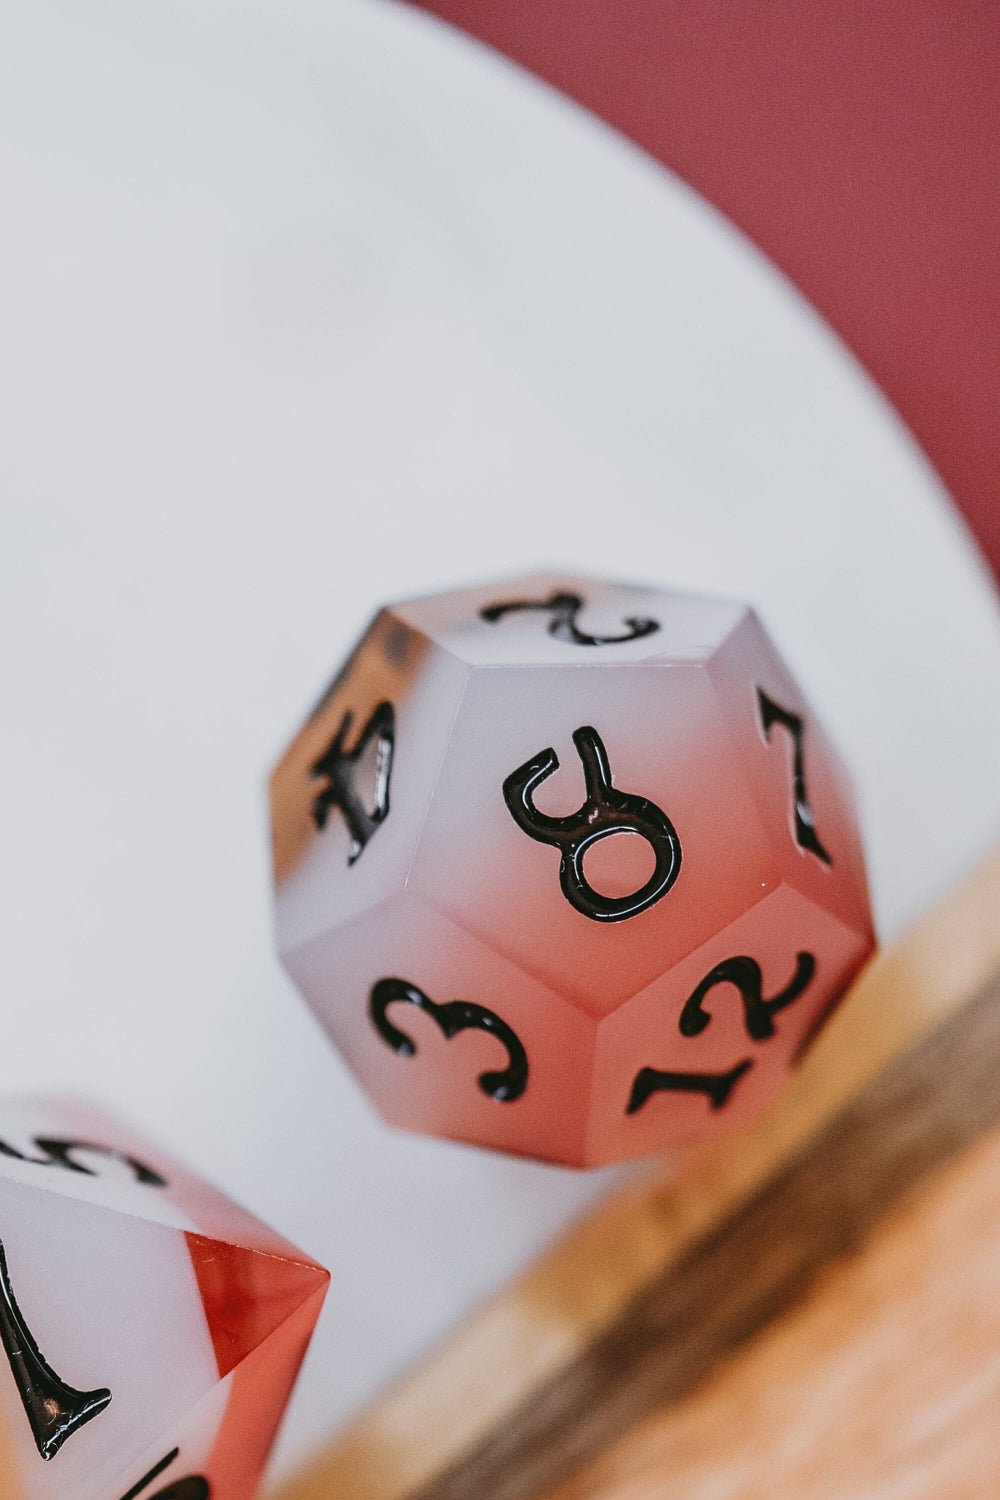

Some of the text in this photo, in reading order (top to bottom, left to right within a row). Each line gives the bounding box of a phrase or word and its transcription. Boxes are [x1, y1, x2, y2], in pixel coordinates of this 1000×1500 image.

[502, 725, 683, 923] 8
[756, 686, 834, 868] 7
[368, 976, 531, 1104] 3
[624, 950, 819, 1116] 12
